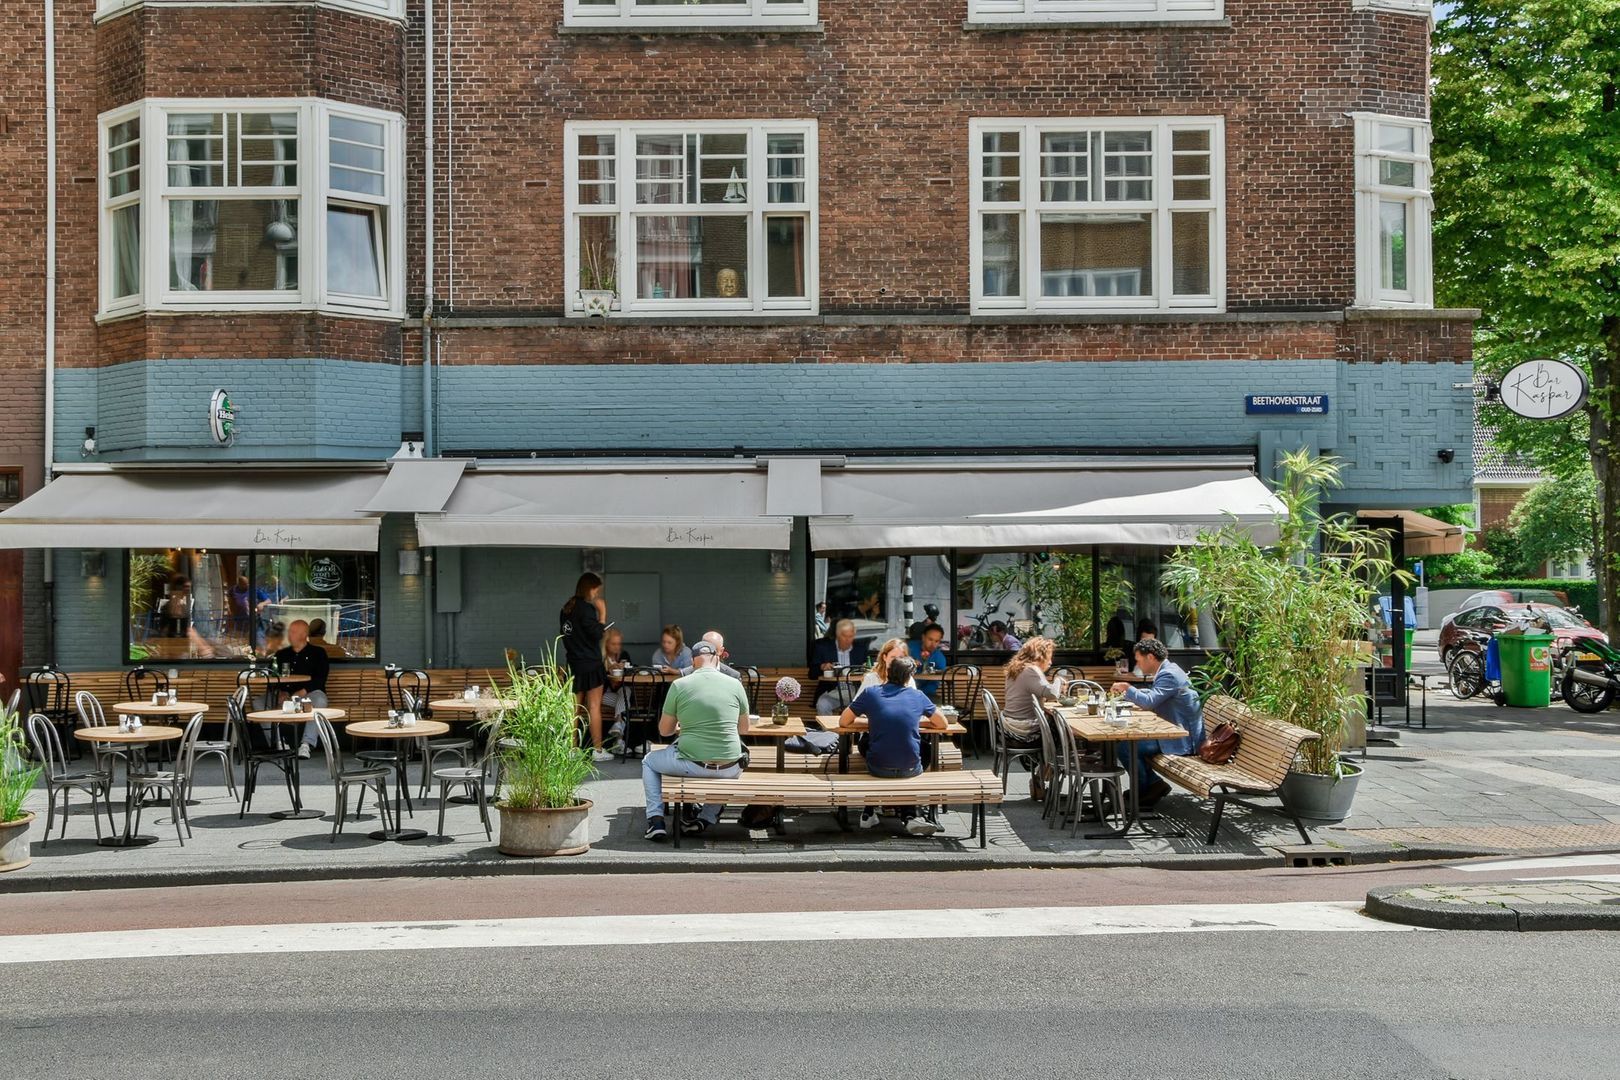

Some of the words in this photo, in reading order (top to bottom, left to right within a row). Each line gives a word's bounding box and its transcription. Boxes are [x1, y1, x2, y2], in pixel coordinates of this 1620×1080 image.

[1533, 362, 1561, 388] Bar
[1252, 396, 1322, 406] BEETHOVENSTRAAT
[1510, 373, 1573, 415] Kaspar
